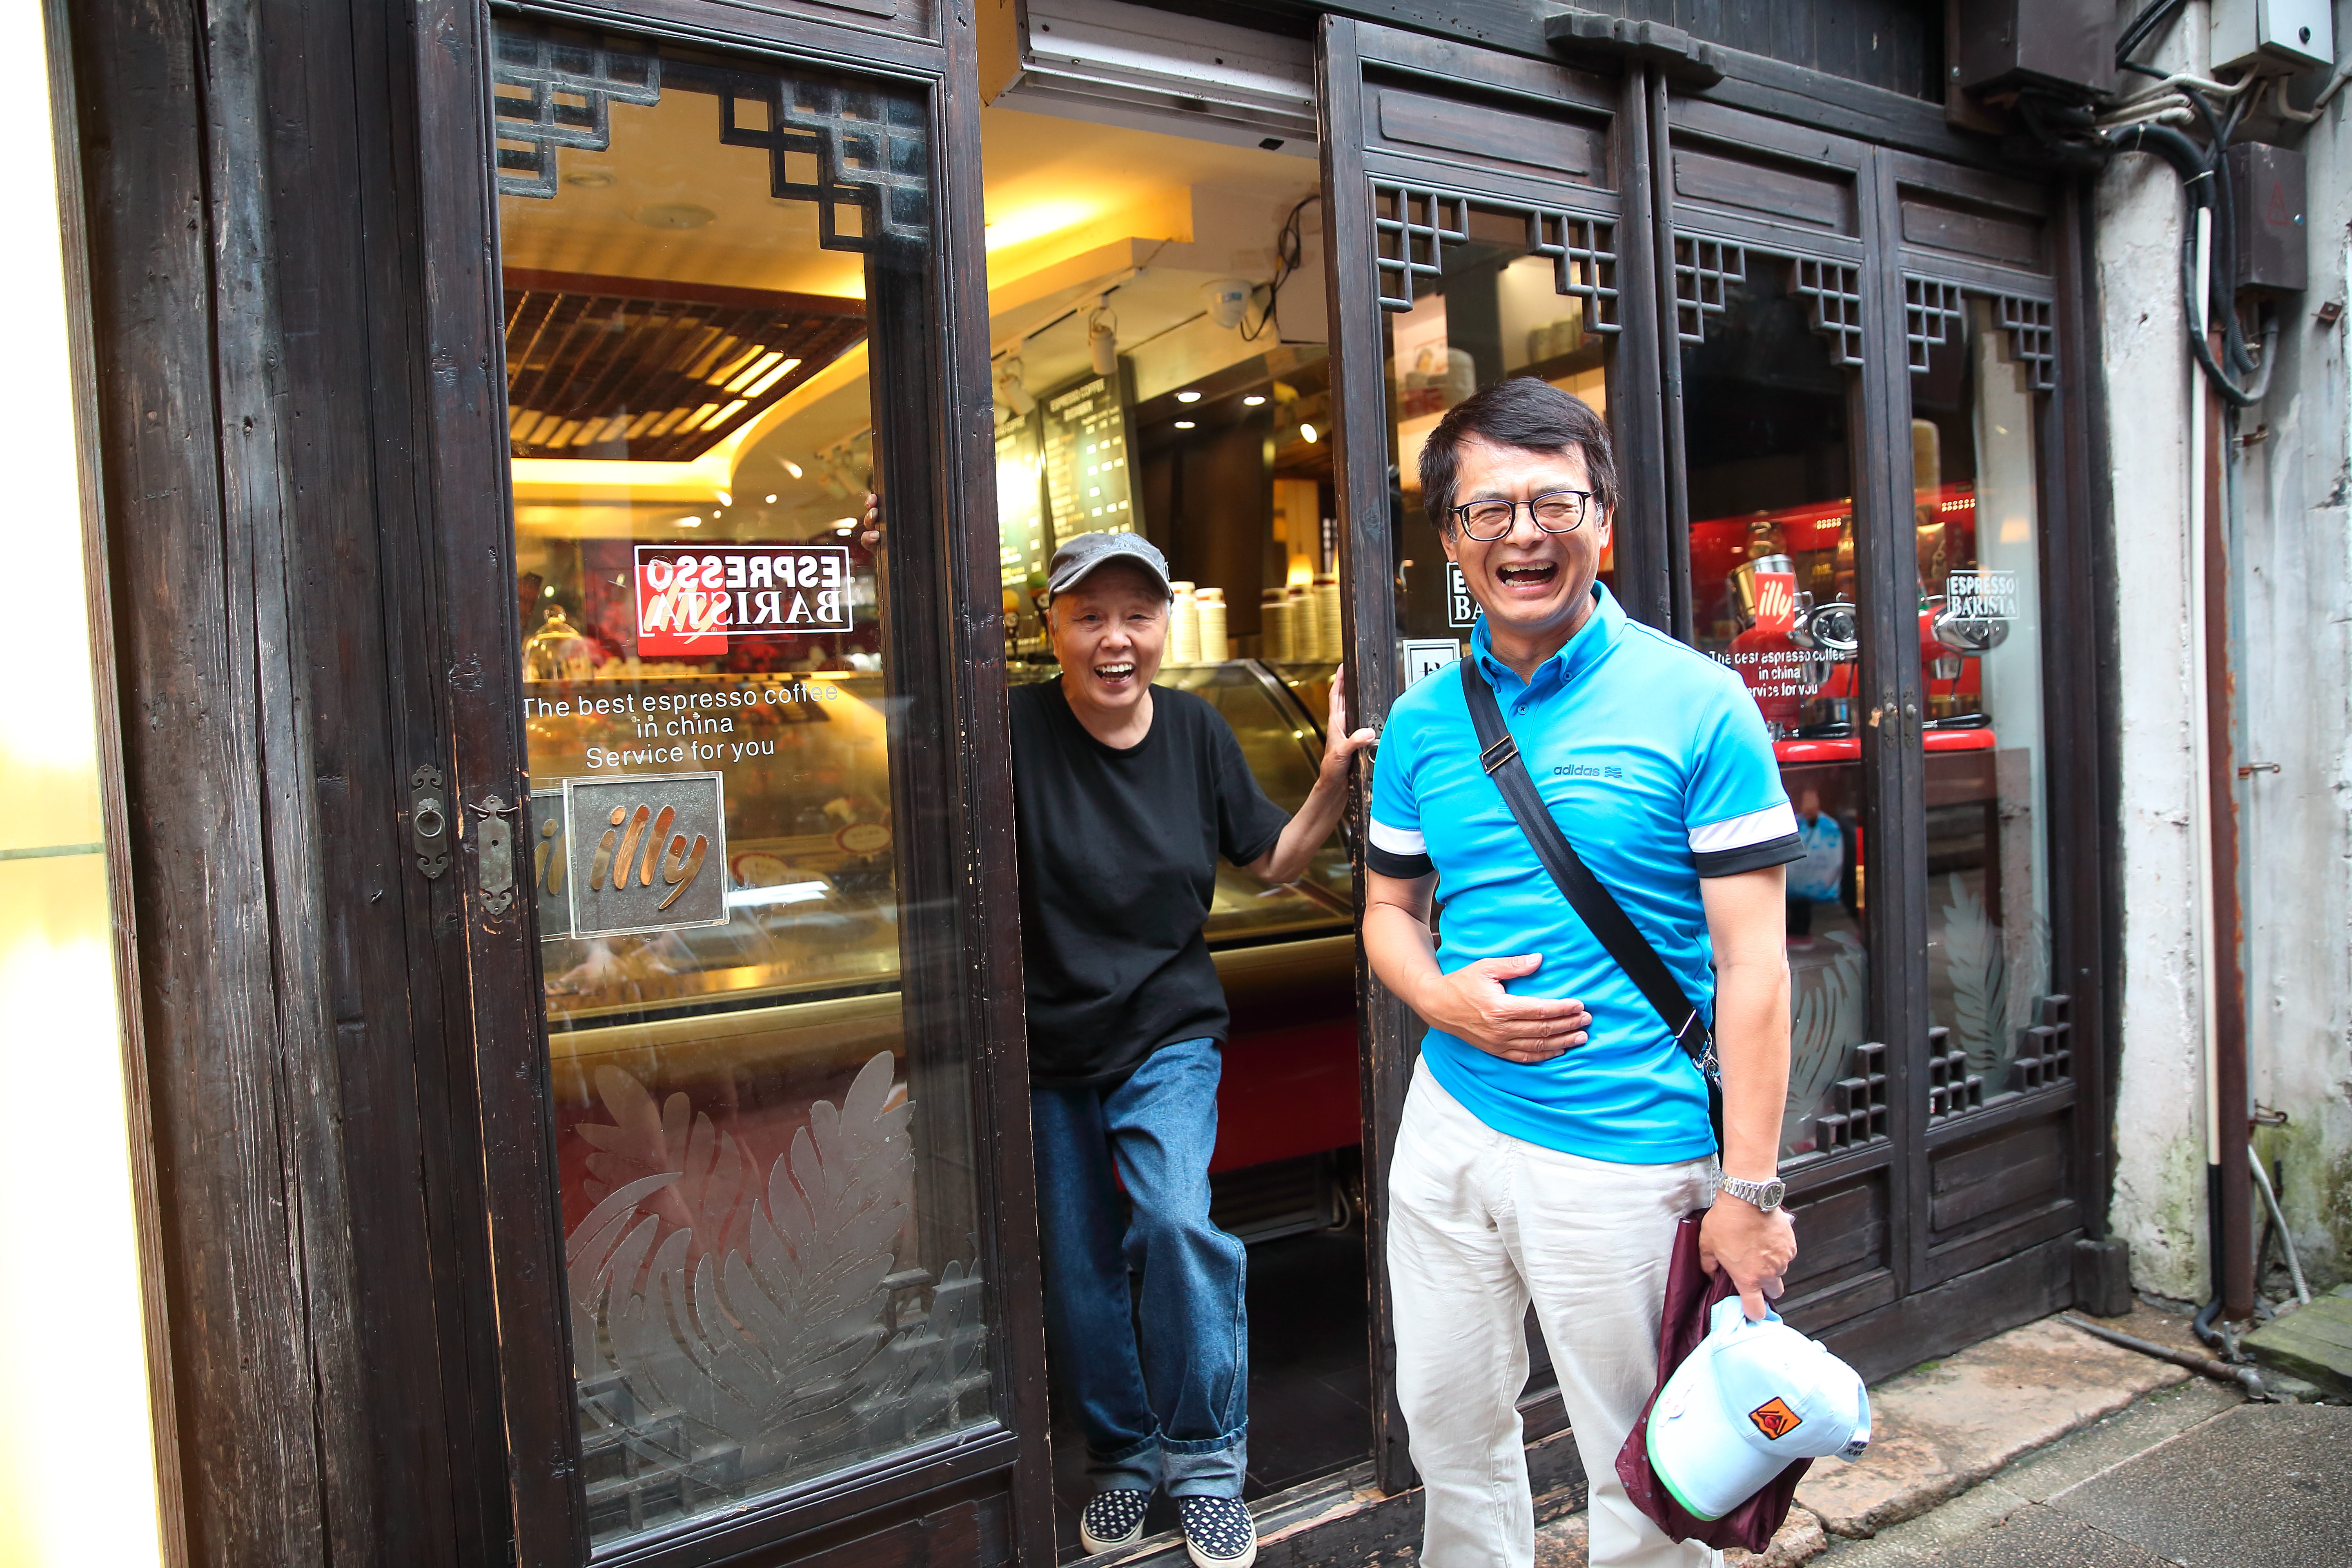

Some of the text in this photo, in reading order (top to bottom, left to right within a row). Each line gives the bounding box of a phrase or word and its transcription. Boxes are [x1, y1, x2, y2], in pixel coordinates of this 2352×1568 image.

[1950, 576, 2015, 595] ESPRESSO
[1758, 579, 1793, 625] illy
[1951, 595, 2016, 616] BARISTA
[1709, 650, 1731, 664] The
[1761, 650, 1811, 665] espresso
[1812, 647, 1845, 661] coffee
[1758, 665, 1801, 680] in china
[1748, 682, 1817, 697] ervice for you
[523, 683, 837, 719] The best espresso coffee
[637, 713, 734, 739] in china
[586, 739, 775, 769] Service for you
[1553, 764, 1600, 776] adidas
[590, 804, 708, 910] illy
